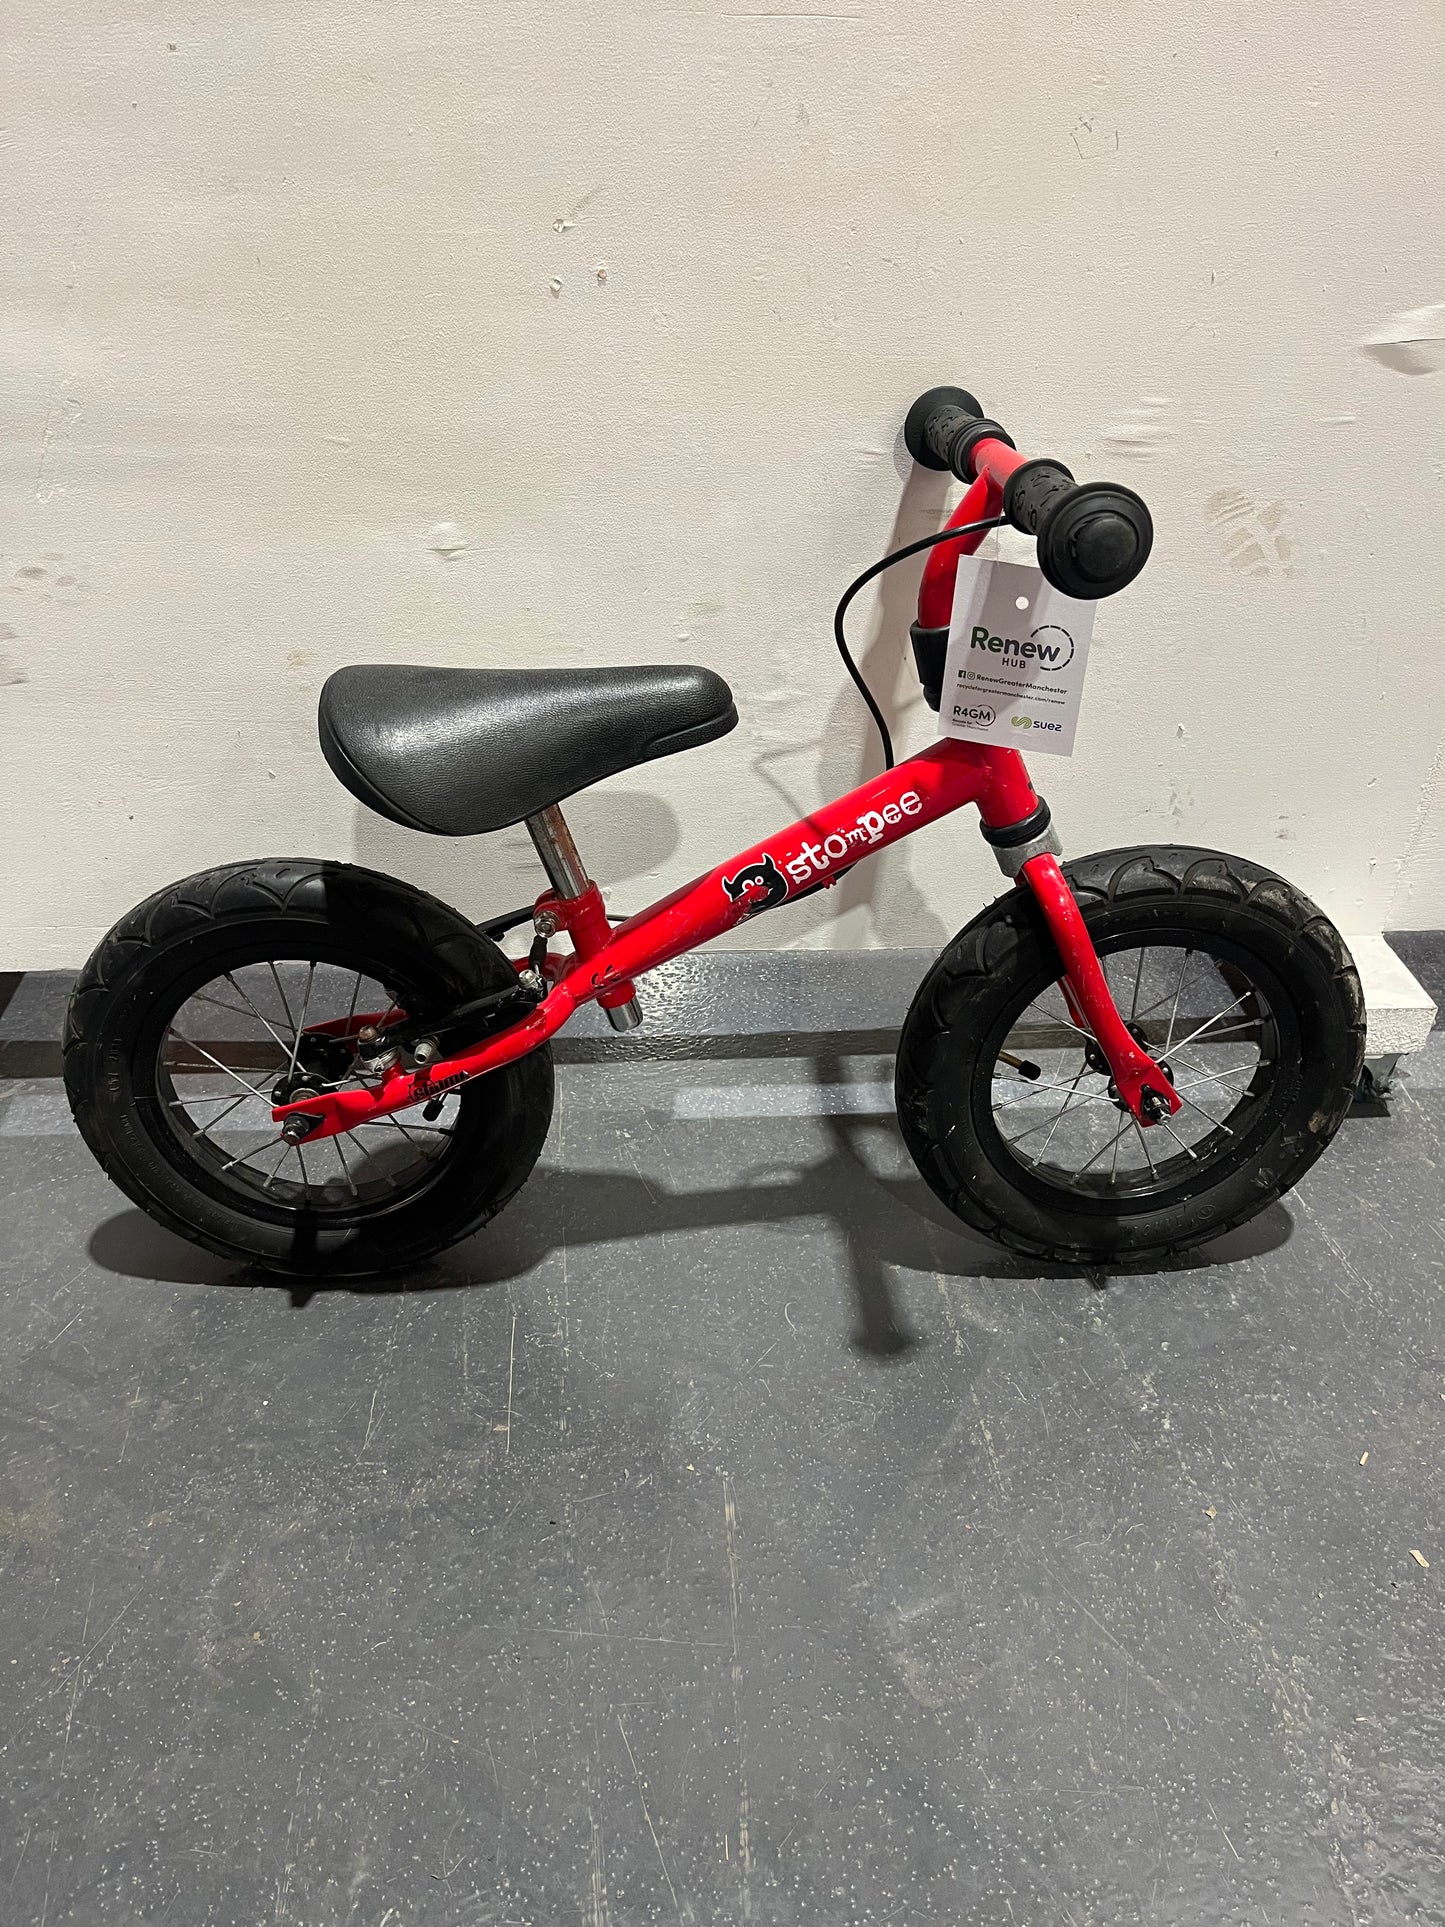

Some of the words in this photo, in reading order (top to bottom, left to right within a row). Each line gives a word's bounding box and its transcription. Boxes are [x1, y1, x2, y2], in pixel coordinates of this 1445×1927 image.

[971, 626, 1061, 662] Renew
[1002, 657, 1026, 669] HUB
[976, 674, 1068, 695] RenewGreaterManchester
[953, 705, 991, 721] R4GM
[1033, 720, 1062, 732] suez
[785, 790, 923, 884] stompee
